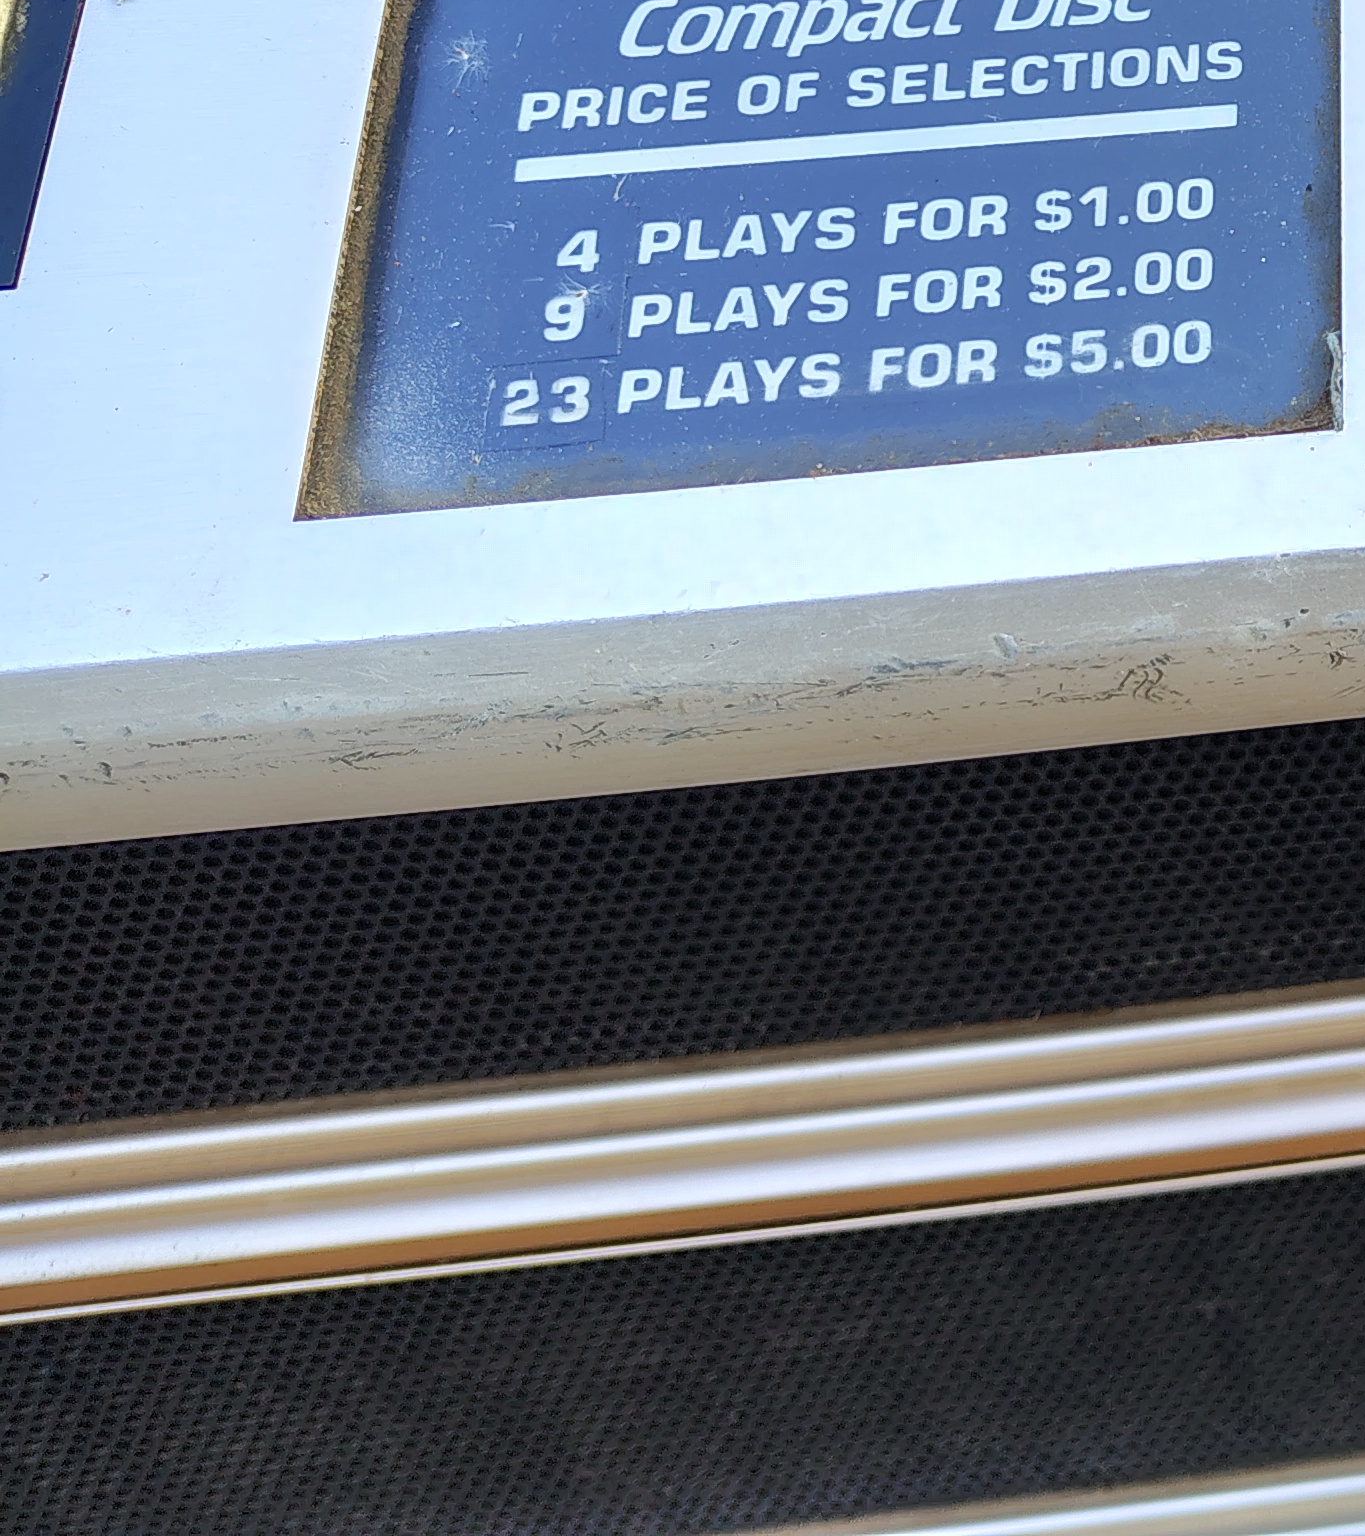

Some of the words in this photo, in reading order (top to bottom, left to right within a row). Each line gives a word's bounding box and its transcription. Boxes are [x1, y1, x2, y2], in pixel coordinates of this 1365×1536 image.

[518, 81, 710, 131] PRICE
[738, 73, 819, 114] OF
[847, 42, 1242, 107] SELECTIONS
[557, 230, 599, 272] 4
[638, 208, 854, 264] PLAYS
[884, 196, 1007, 244] FOR
[1035, 179, 1213, 232] $1.00
[544, 299, 588, 341] 9
[628, 280, 848, 337] PLAYS
[877, 267, 1002, 316] FOR
[1029, 249, 1212, 305] $2.00
[501, 375, 590, 426] 23
[618, 354, 840, 413] PLAYS
[869, 340, 997, 391] FOR
[1025, 321, 1211, 378] $5.00
